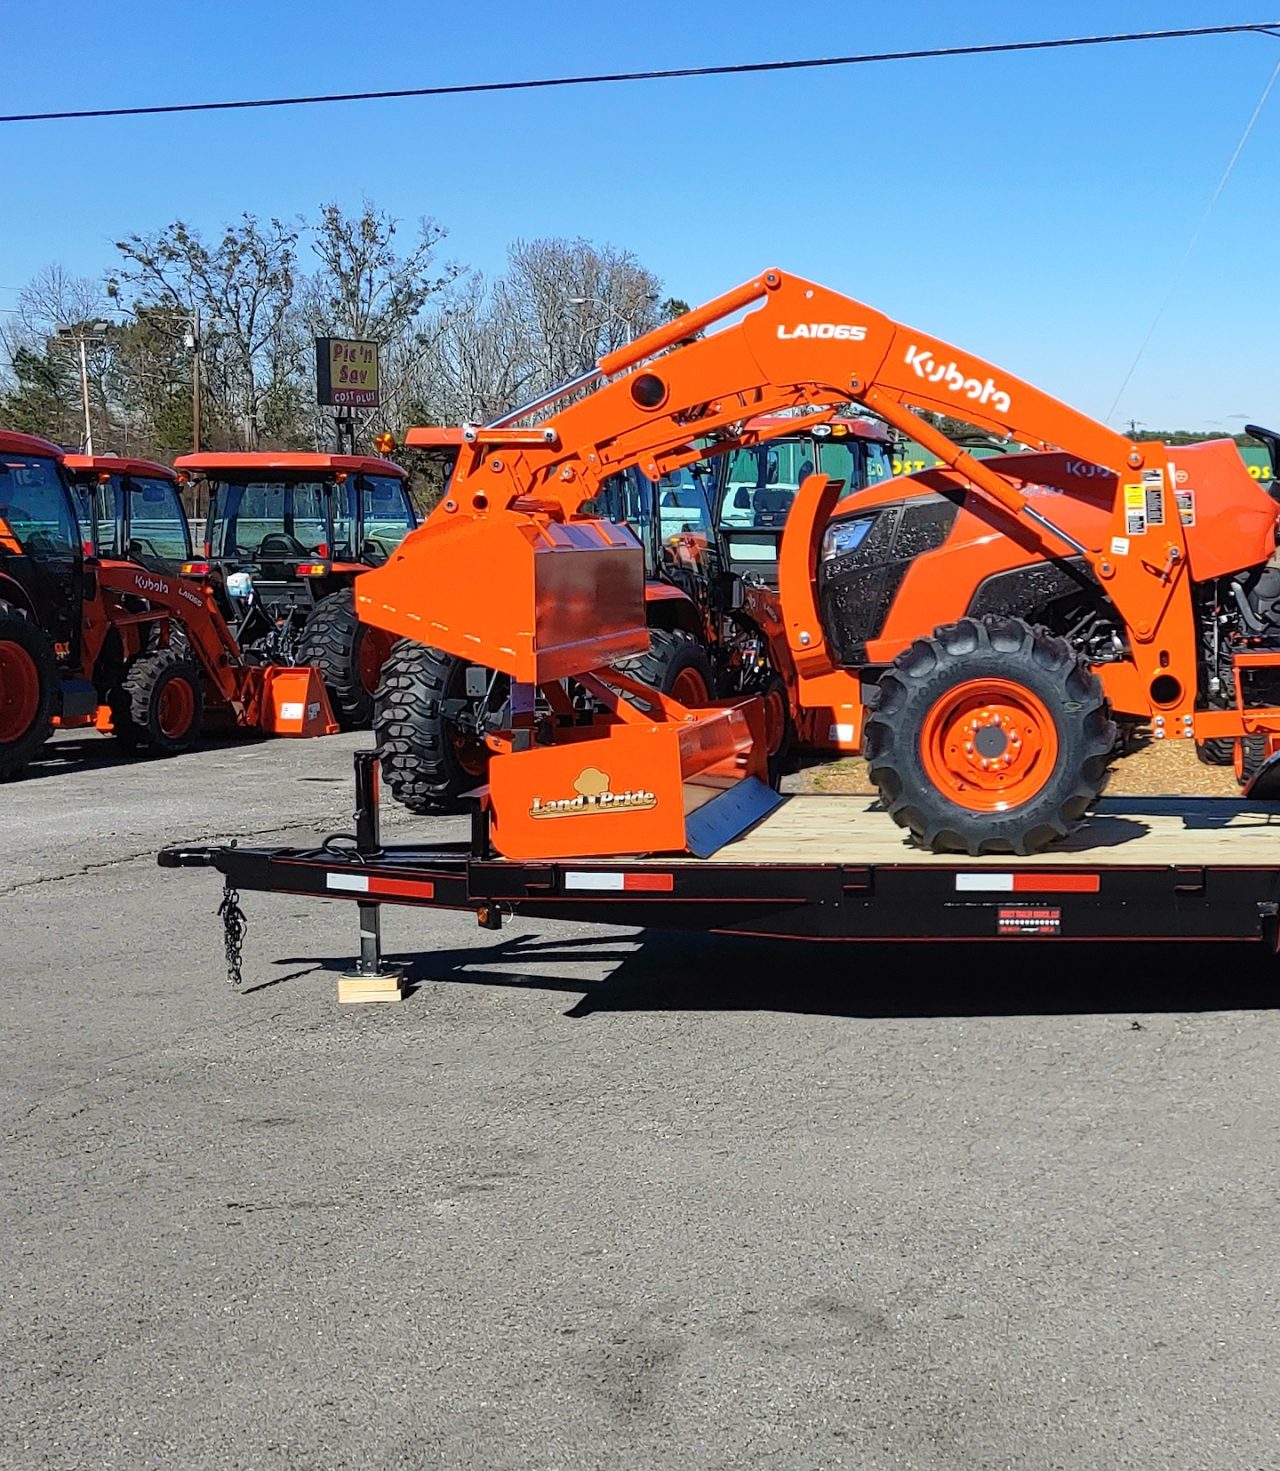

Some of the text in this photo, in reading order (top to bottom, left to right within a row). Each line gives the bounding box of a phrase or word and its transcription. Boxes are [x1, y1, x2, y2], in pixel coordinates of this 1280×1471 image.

[776, 323, 868, 341] LA1065
[339, 364, 368, 384] Sav
[903, 345, 1012, 413] Kubota
[334, 391, 355, 402] COST
[134, 574, 169, 594] Kubota
[531, 789, 656, 813] Land Pride
